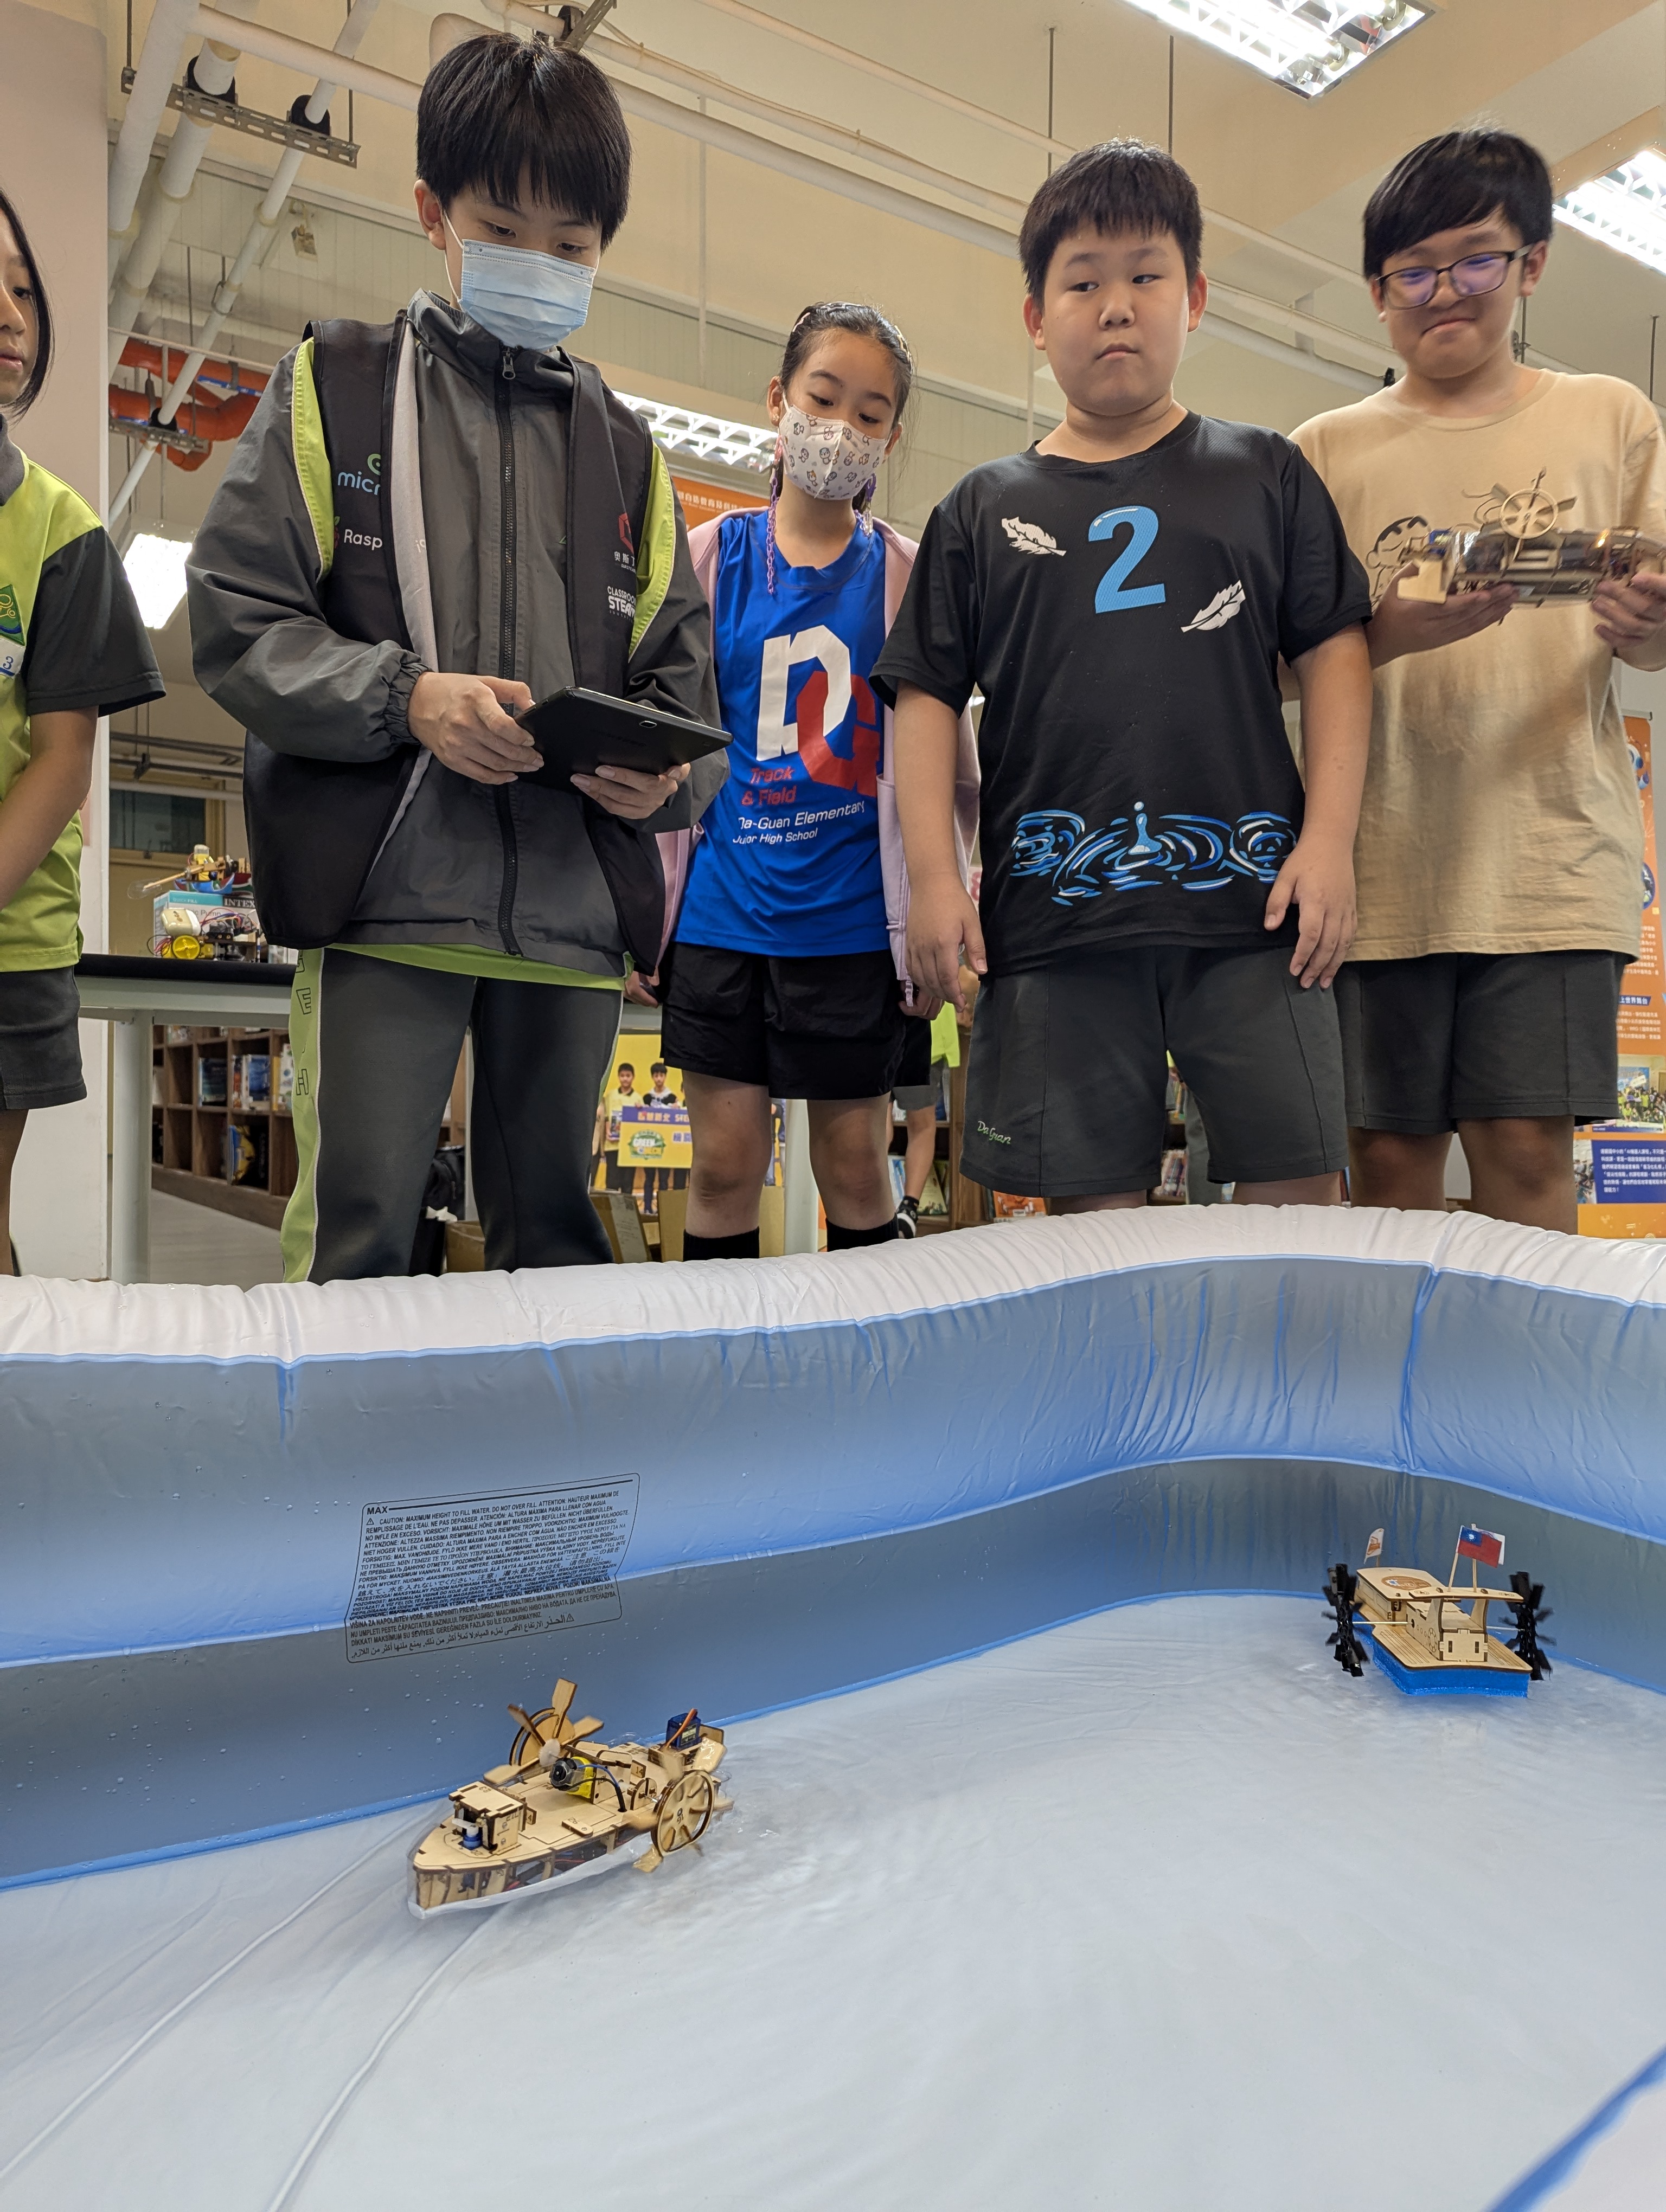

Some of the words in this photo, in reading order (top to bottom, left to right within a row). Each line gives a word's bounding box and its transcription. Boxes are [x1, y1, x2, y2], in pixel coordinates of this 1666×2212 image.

[1088, 505, 1166, 614] 2
[3, 656, 14, 670] 3
[749, 766, 795, 785] Track
[741, 790, 754, 806] &
[758, 786, 797, 806] Field
[794, 800, 865, 827] Elementary
[759, 833, 783, 845] High
[785, 828, 818, 843] School
[225, 898, 256, 908] INTEX
[367, 1506, 387, 1515] MAX
[366, 1525, 403, 1534] REMPLISSAGE
